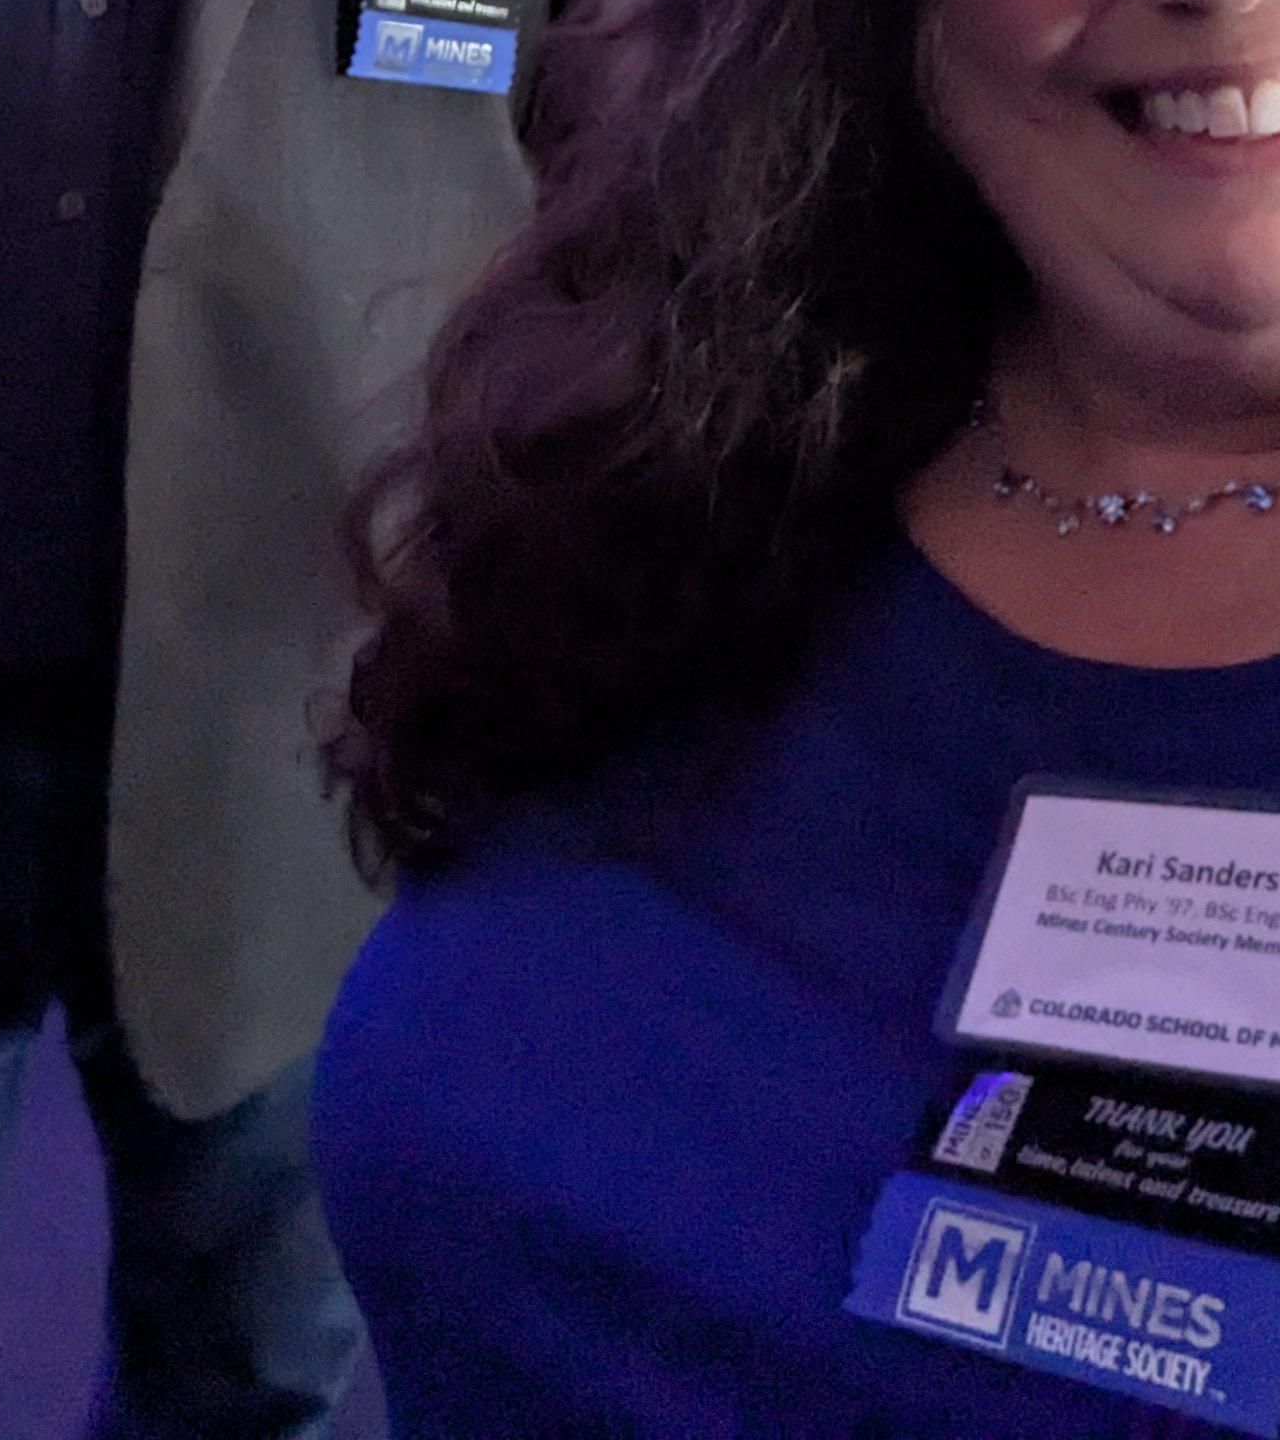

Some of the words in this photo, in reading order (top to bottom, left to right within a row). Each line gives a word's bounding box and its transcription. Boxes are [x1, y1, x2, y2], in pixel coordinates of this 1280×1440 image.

[426, 37, 494, 66] MINES
[1097, 851, 1154, 878] Kari
[1160, 856, 1280, 892] Sanders
[1046, 884, 1078, 905] BSc
[1083, 887, 1118, 913] Eng
[1122, 890, 1160, 916] Phy
[1205, 901, 1239, 923] BSc
[1036, 911, 1090, 935] Mines
[1094, 918, 1161, 943] Century
[1165, 926, 1230, 951] Society
[1029, 997, 1142, 1030] COLORADO
[1146, 1013, 1231, 1043] SCHOOL
[1236, 1026, 1266, 1046] OF
[1083, 1096, 1182, 1140] THANK
[1185, 1117, 1256, 1156] YOU
[1070, 1157, 1137, 1191] talent
[1139, 1176, 1186, 1202] and
[1146, 1150, 1190, 1171] your
[1036, 1251, 1228, 1351] MINES
[1026, 1312, 1127, 1372] HERITAGE
[1124, 1341, 1213, 1395] SOCIETY
